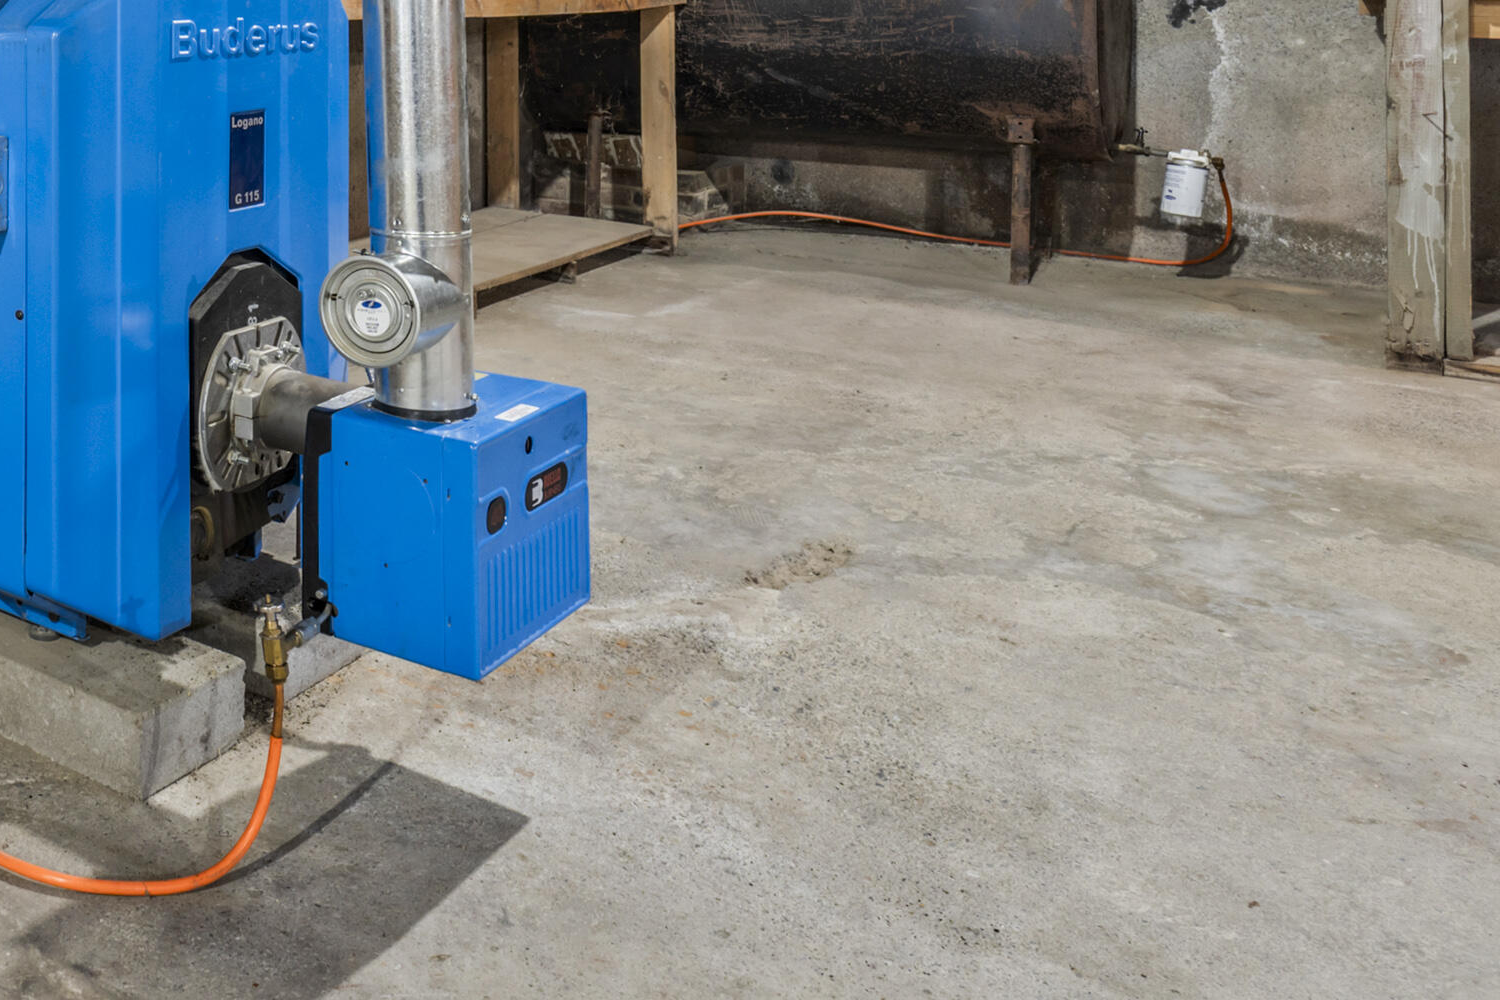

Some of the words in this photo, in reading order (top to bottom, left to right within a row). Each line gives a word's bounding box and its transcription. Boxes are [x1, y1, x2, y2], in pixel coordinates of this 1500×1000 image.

[171, 17, 319, 60] Buderus
[231, 115, 263, 130] Logano
[235, 193, 242, 205] G
[245, 190, 260, 203] 115
